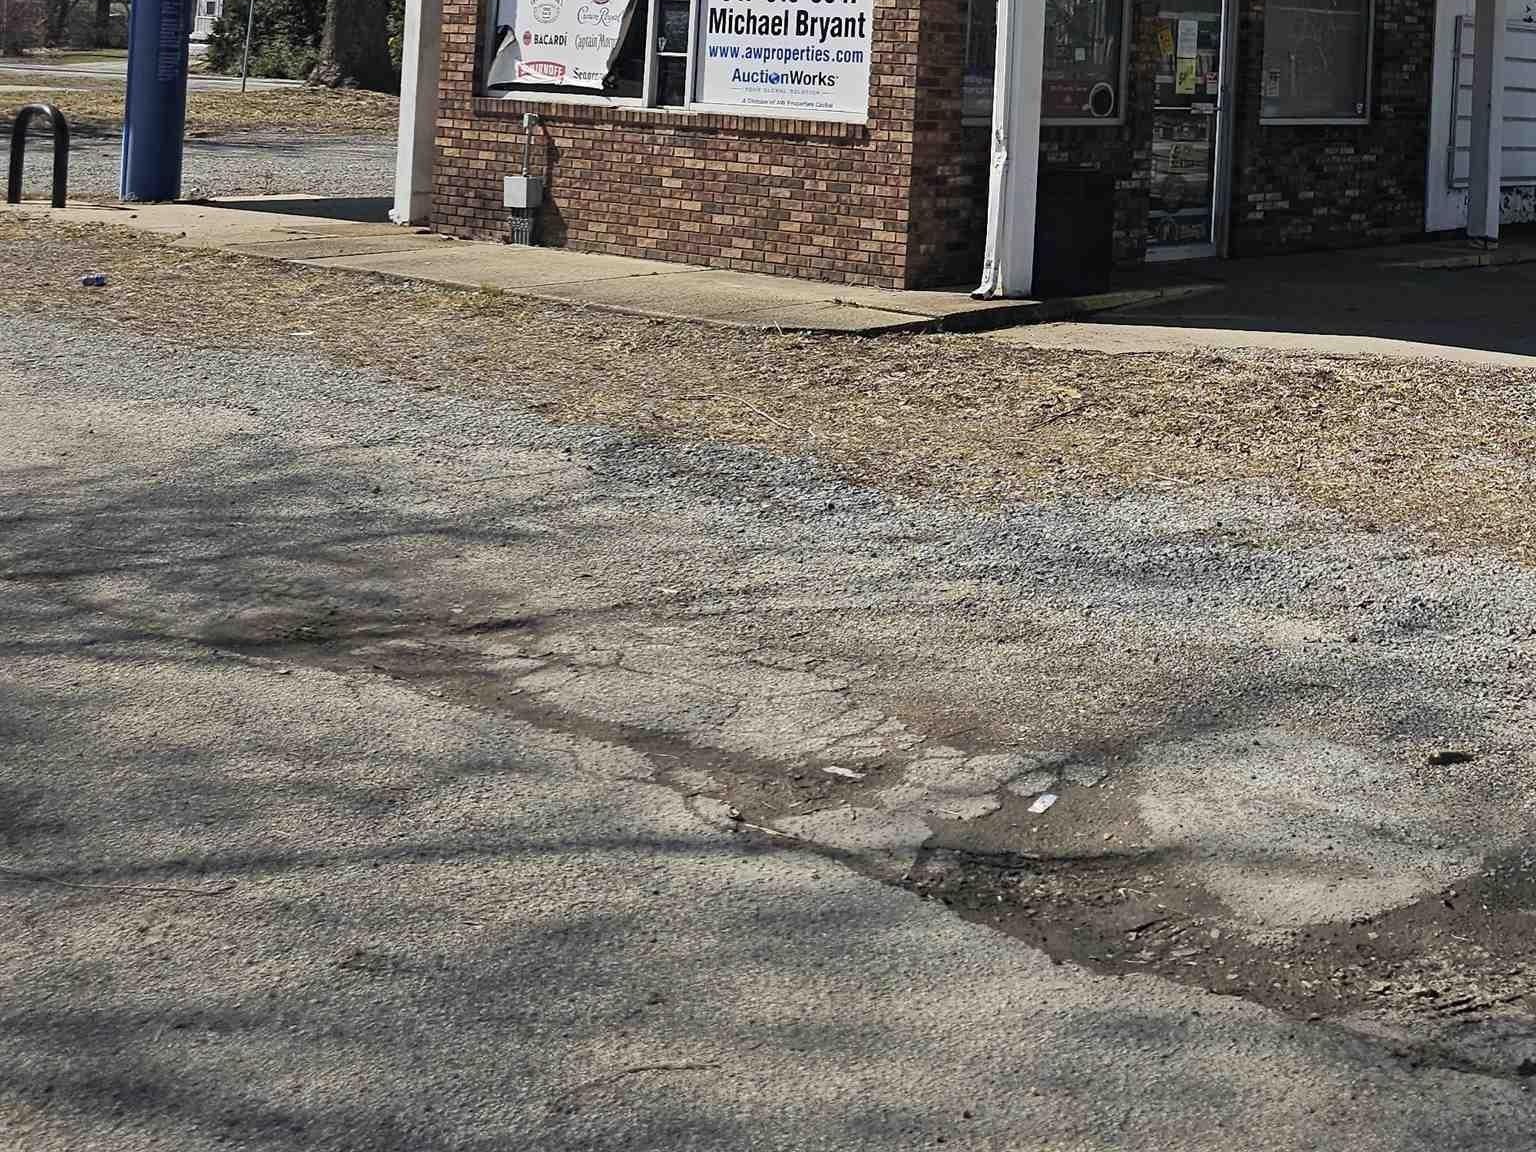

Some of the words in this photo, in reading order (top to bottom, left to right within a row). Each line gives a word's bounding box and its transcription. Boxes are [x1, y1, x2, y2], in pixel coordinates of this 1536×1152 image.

[709, 8, 789, 36] Michael
[795, 10, 866, 43] Bryant
[709, 46, 864, 64] www.awproperties.com
